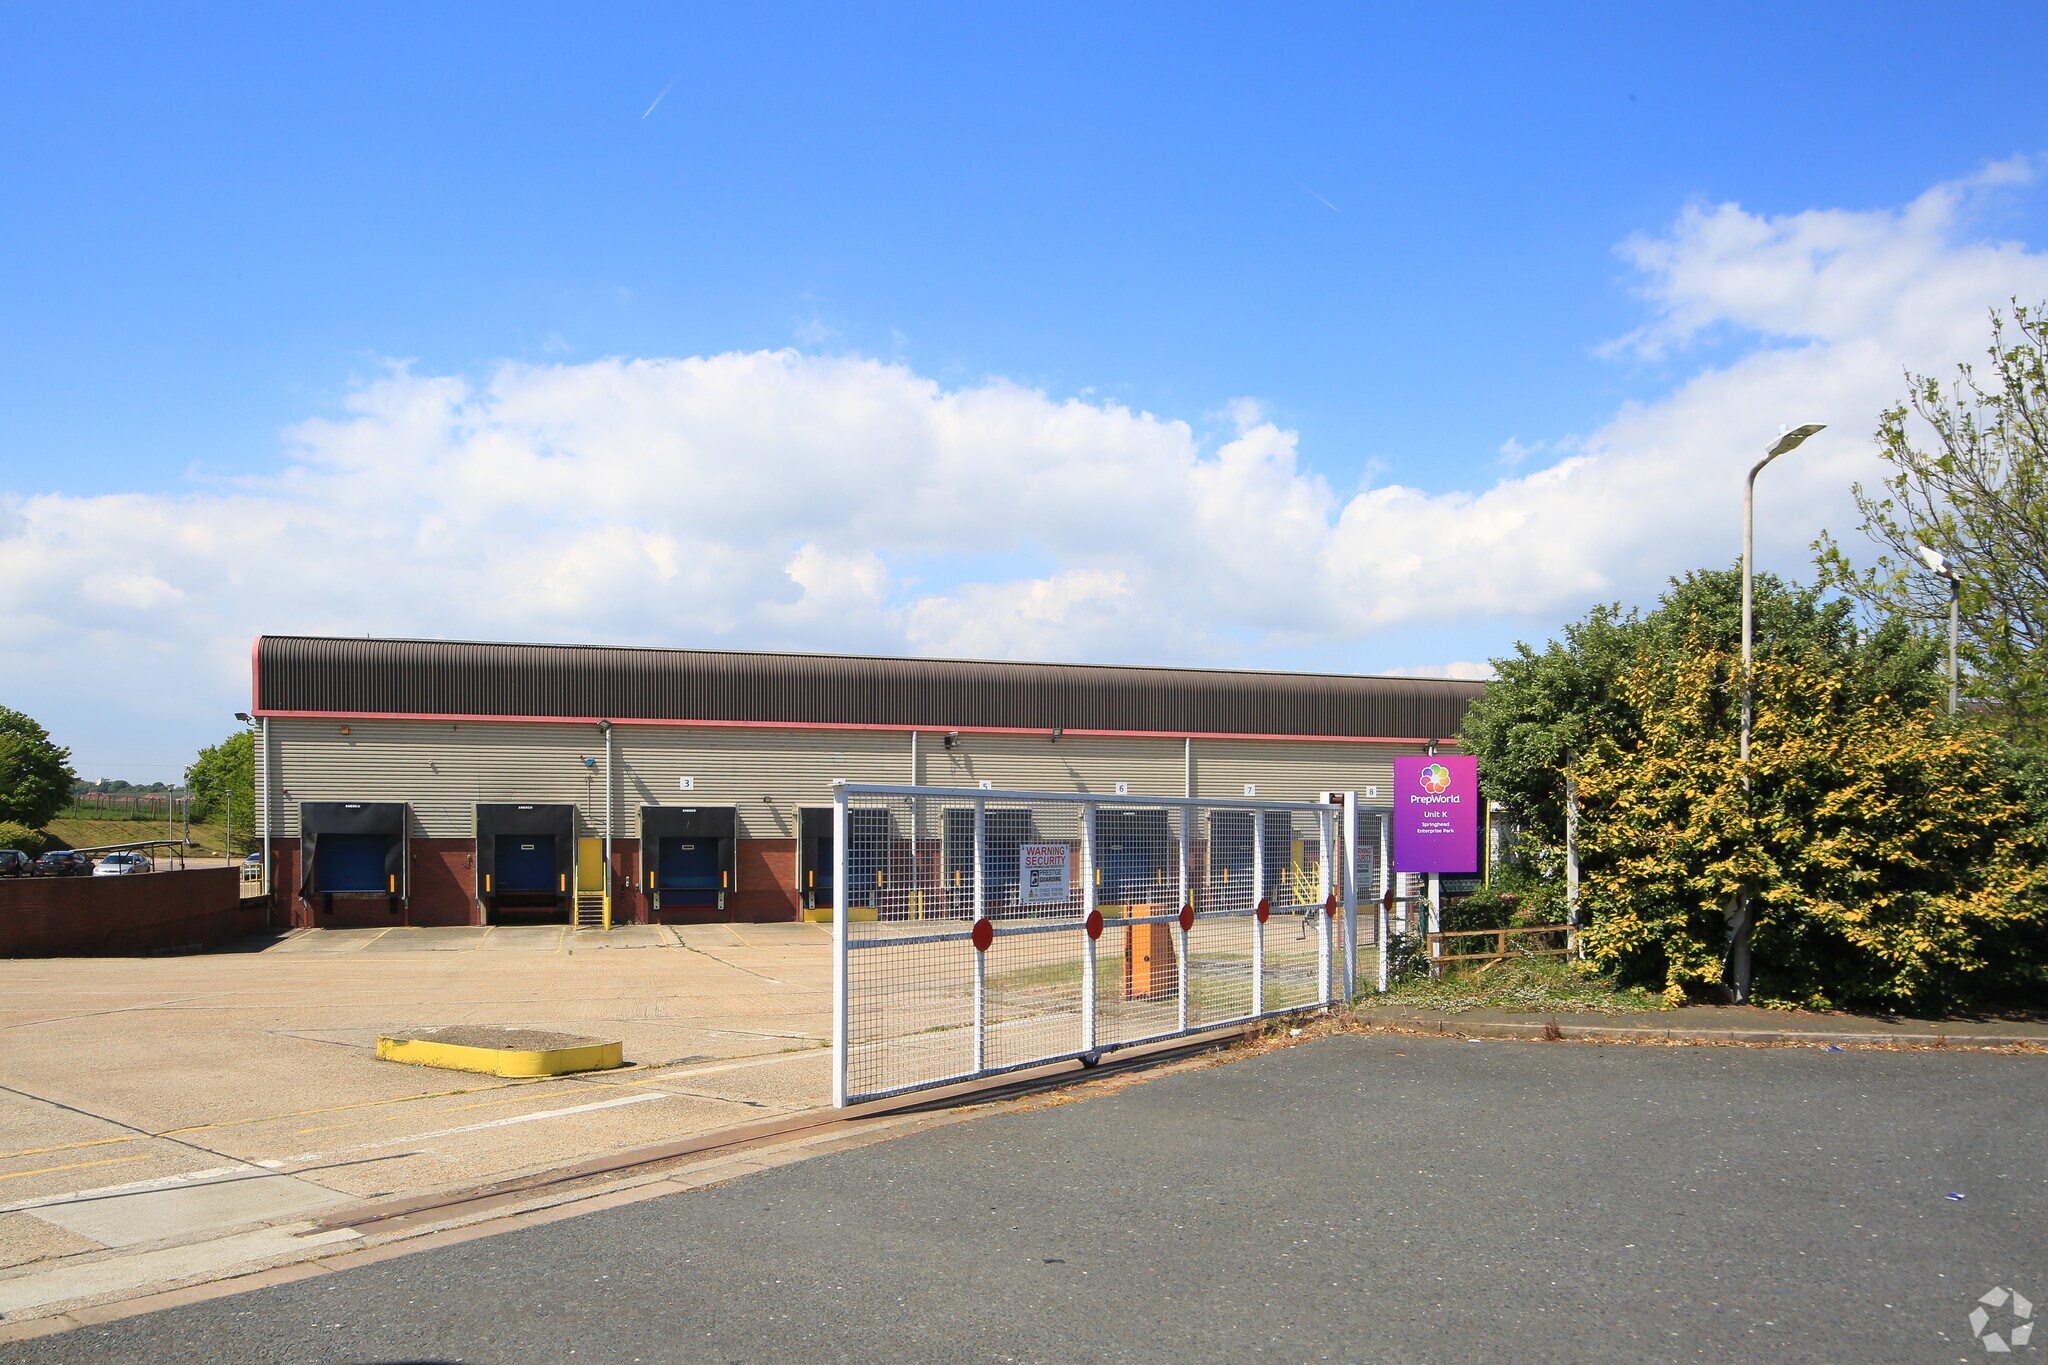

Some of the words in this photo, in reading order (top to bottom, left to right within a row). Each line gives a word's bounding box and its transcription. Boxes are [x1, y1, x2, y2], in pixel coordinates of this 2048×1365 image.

[684, 779, 694, 788] 3
[1119, 784, 1124, 792] 6
[1410, 795, 1460, 805] PrepWorld
[1026, 847, 1065, 856] WARNING
[1025, 856, 1066, 866] SECURITY
